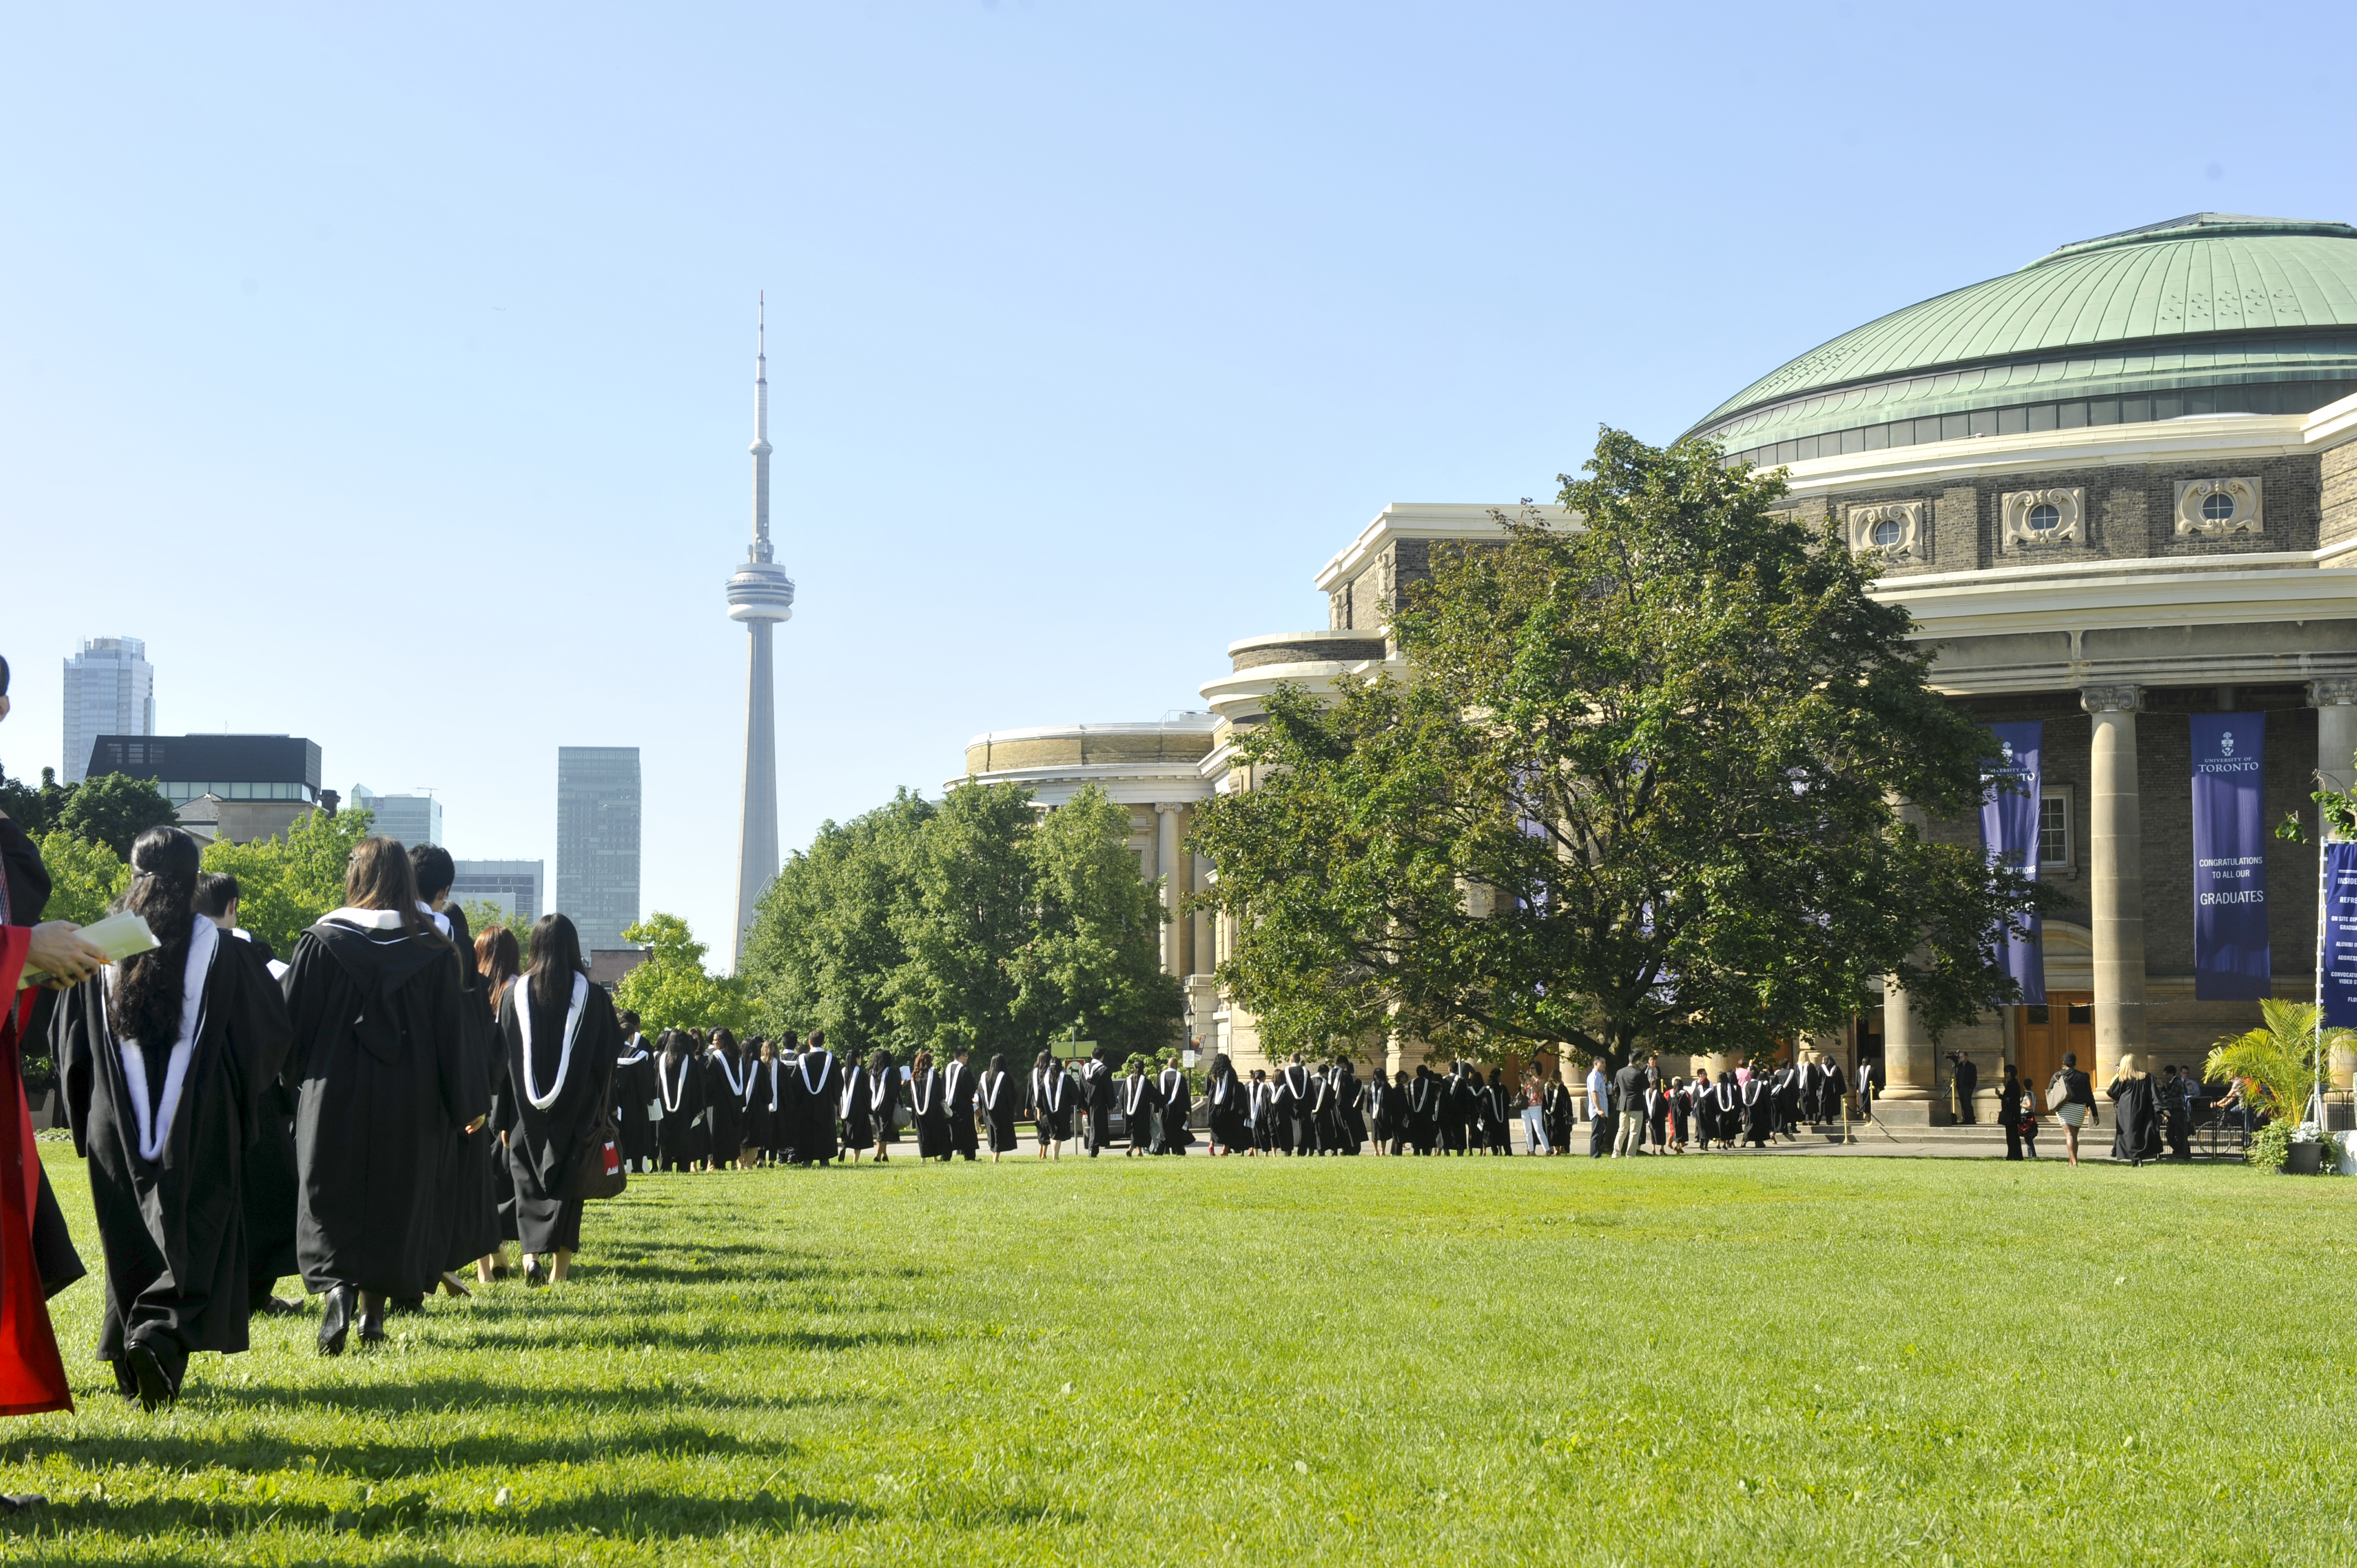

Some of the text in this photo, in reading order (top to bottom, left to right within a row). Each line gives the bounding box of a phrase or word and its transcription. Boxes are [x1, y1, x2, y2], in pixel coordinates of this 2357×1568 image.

[2198, 762, 2258, 772] TORONTO
[2199, 857, 2262, 867] CONGRATULATIONS
[2212, 871, 2221, 879] TO
[2236, 869, 2250, 878] OUR
[2200, 890, 2264, 905] GRADUATES
